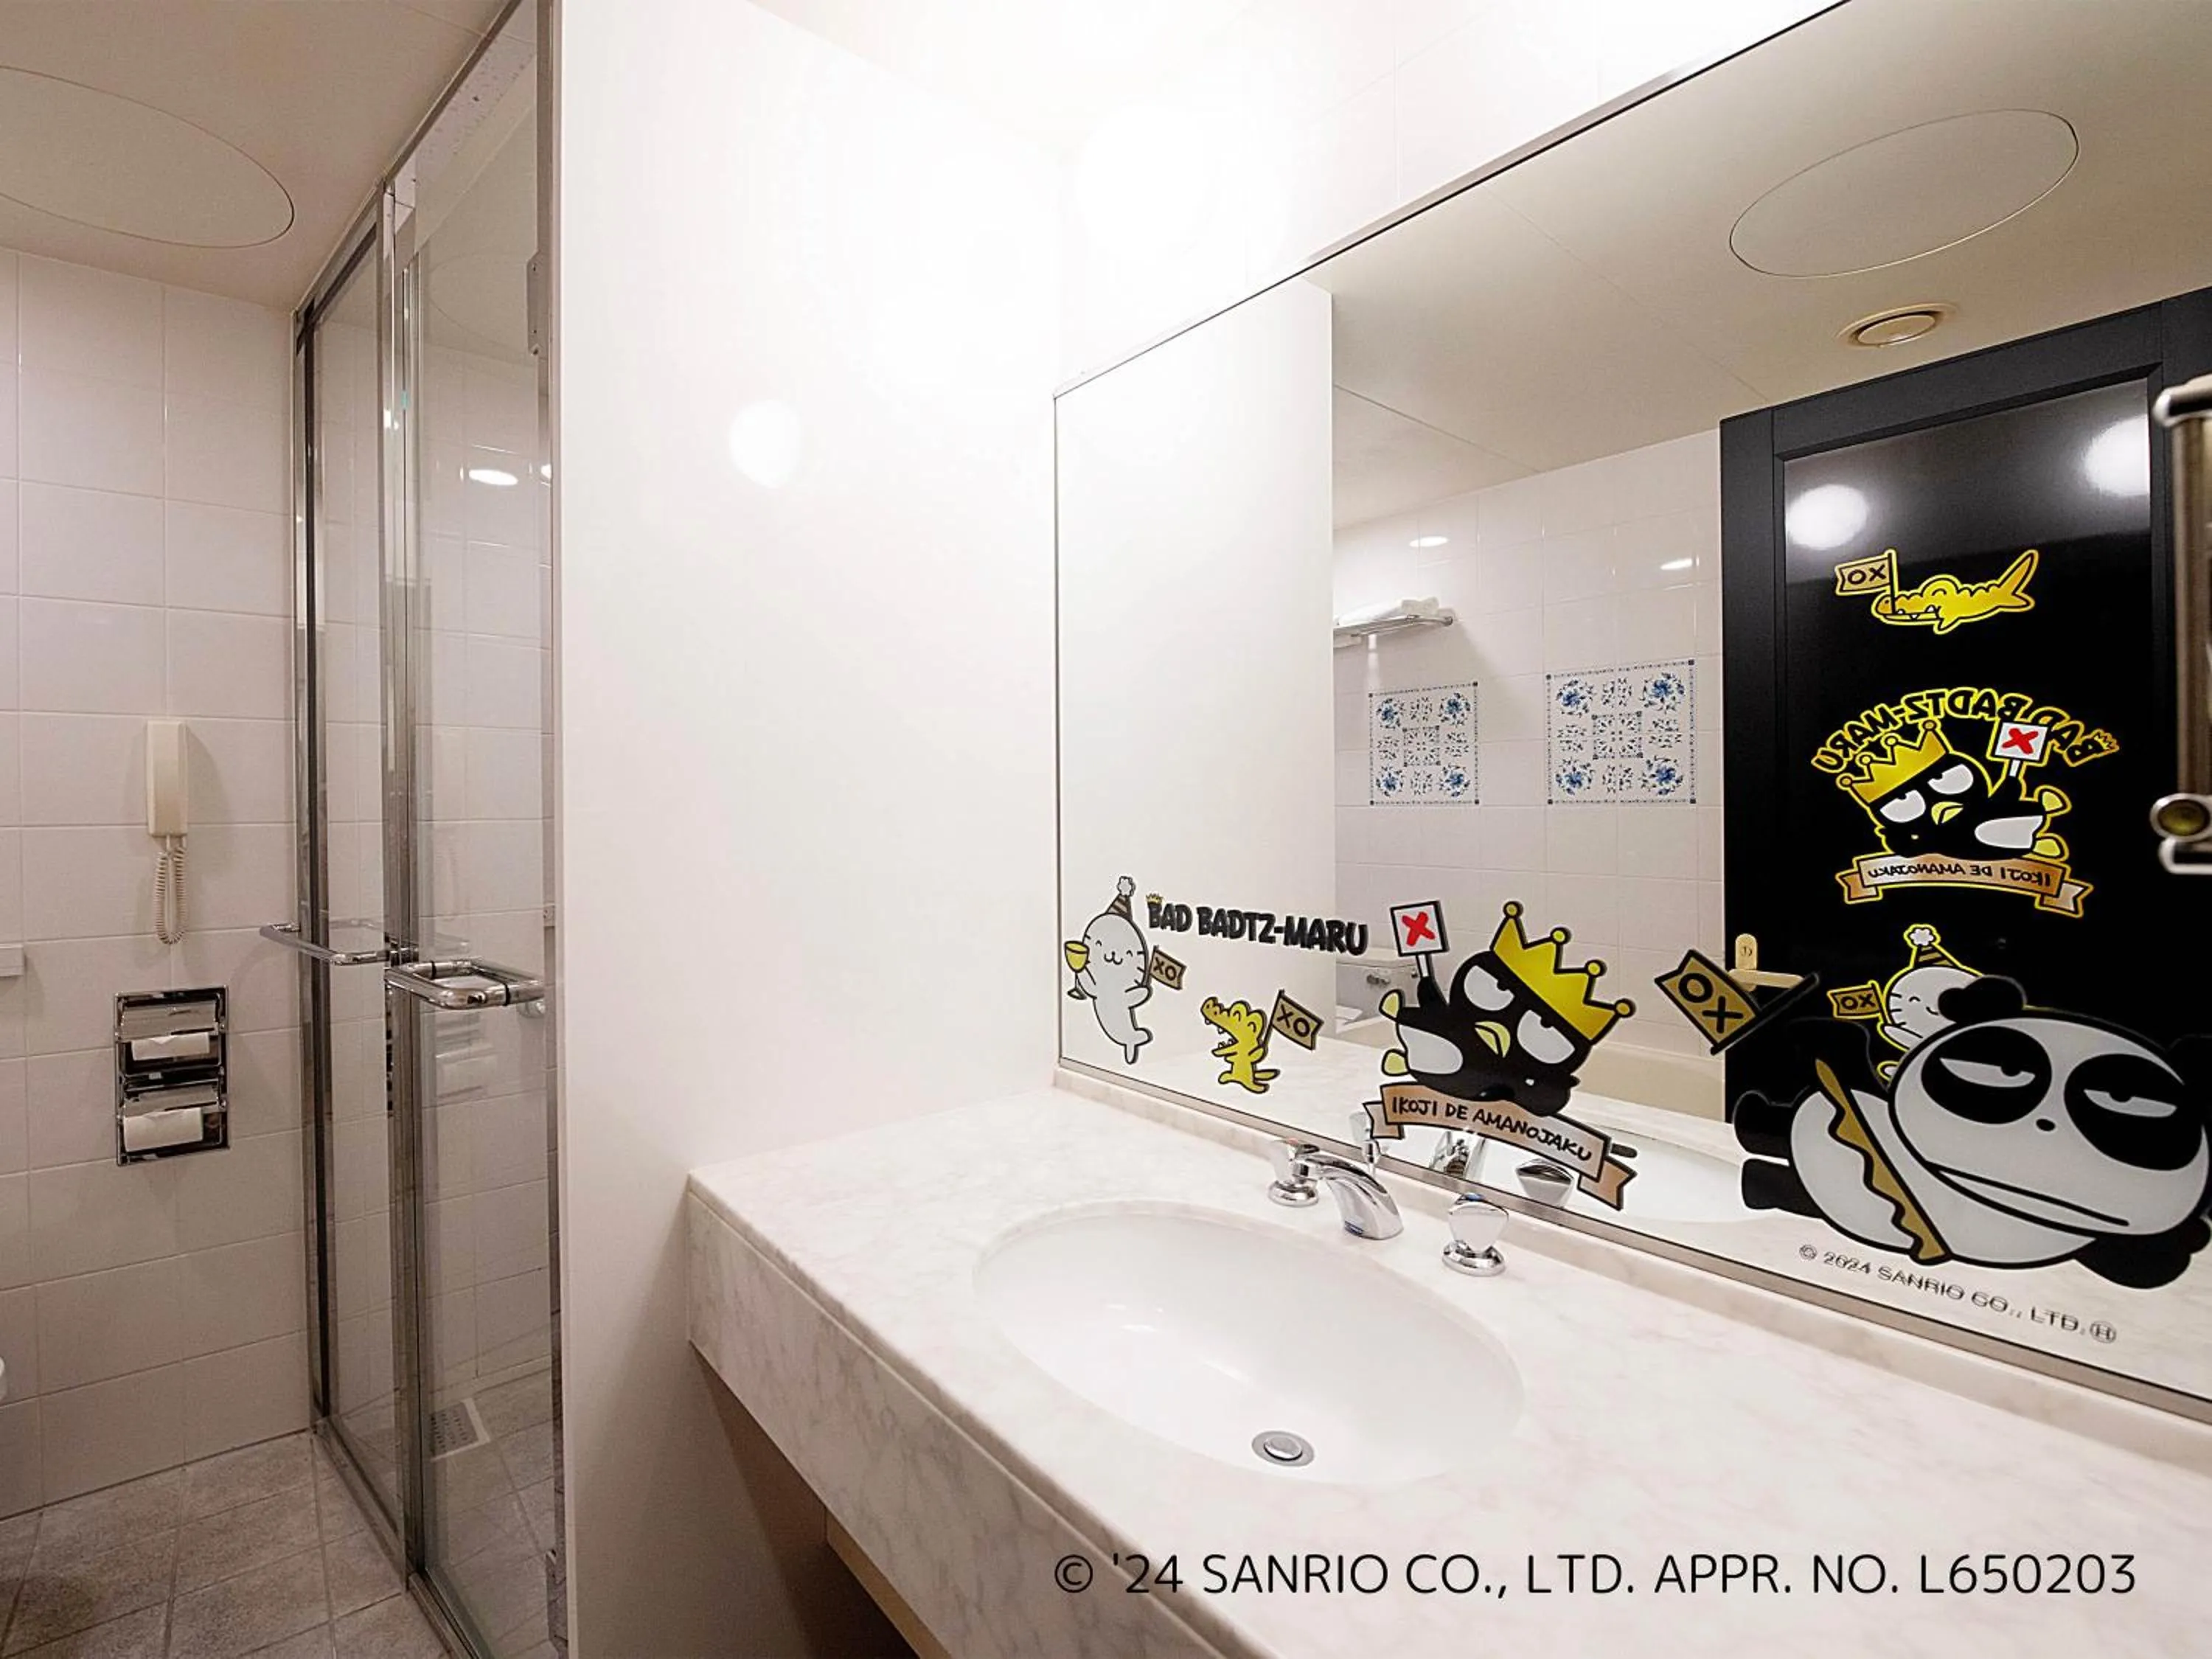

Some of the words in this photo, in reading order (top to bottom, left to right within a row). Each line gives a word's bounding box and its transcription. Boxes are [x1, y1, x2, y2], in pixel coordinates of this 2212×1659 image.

[1147, 902, 1193, 933] BAD
[1196, 906, 1369, 956] BADTZ-MARU
[1392, 1096, 1437, 1116] IKOJI
[1444, 1102, 1468, 1120] DE
[1472, 1108, 1593, 1162] AMANOJAKU
[1823, 1251, 1871, 1275] 2024
[1877, 1267, 1965, 1301] SANRIO
